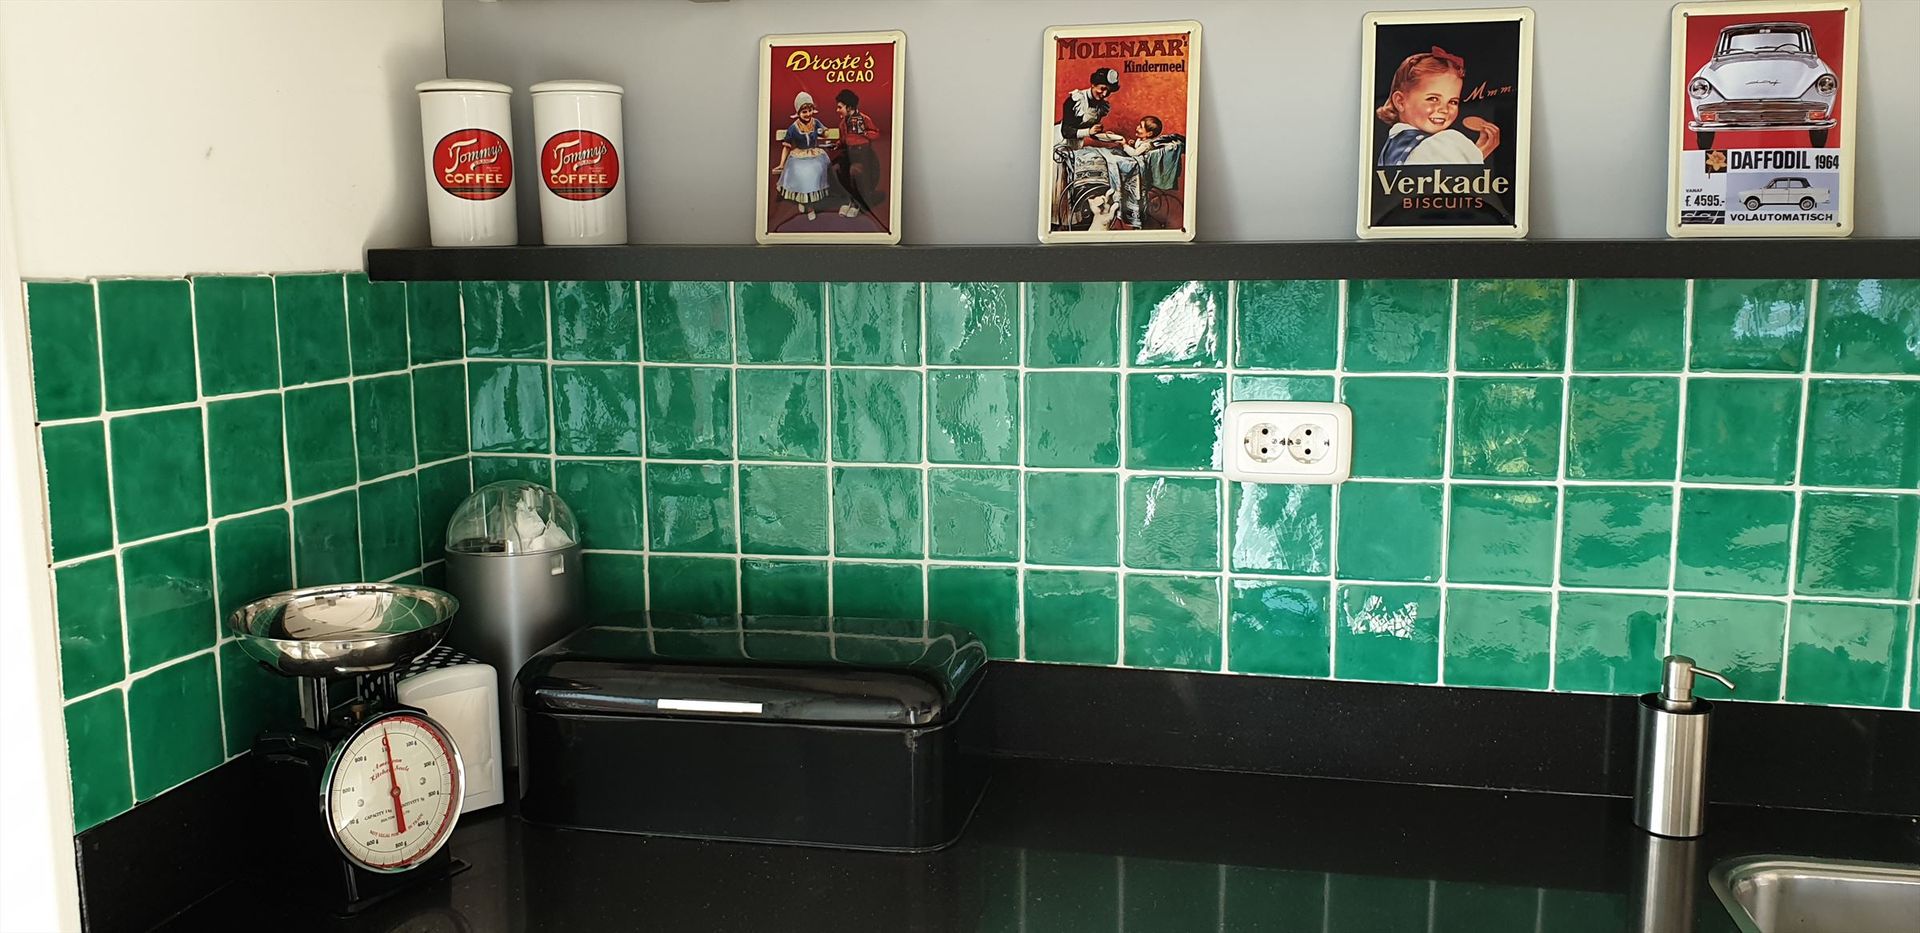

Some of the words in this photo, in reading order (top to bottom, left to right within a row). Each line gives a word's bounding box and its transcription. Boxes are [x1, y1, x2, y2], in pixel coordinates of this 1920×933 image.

[786, 50, 875, 71] Droste's
[1123, 60, 1185, 73] Kindermeel
[826, 70, 874, 83] CACAO
[444, 138, 503, 174] Tommy's
[550, 139, 608, 175] Tommy's
[1731, 150, 1811, 170] DAFFODIL
[1815, 154, 1840, 170] 1964
[445, 173, 504, 184] COFFEE
[550, 174, 608, 184] COFFEE
[1376, 169, 1509, 195] Verkade
[1403, 197, 1484, 209] BISCUITS
[1730, 213, 1833, 222] VOLAUTOMATISCH
